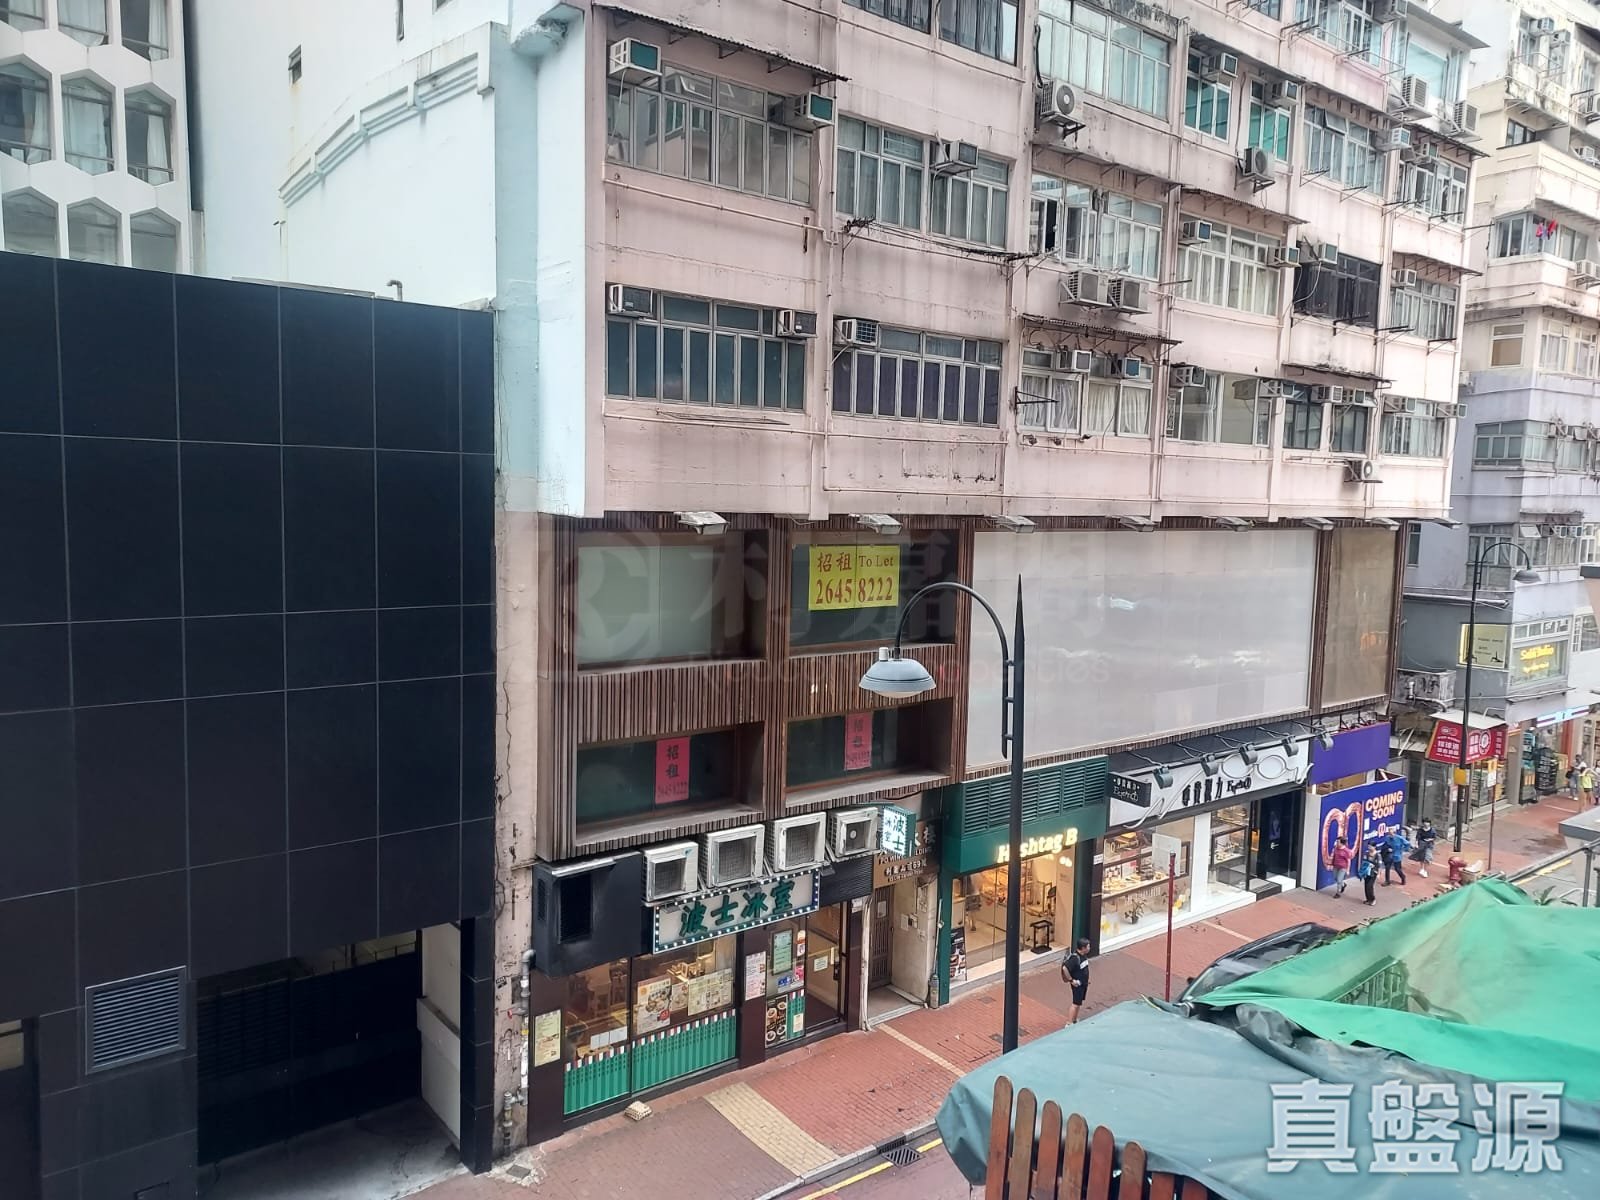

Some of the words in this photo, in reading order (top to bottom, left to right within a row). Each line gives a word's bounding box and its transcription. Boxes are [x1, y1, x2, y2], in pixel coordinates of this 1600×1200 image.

[817, 551, 852, 572] 招租
[858, 555, 873, 567] To
[876, 555, 894, 567] Let
[1366, 791, 1403, 811] COMING
[1372, 804, 1395, 820] SOON
[892, 815, 905, 852] 波士
[996, 832, 1064, 864] Hshtag
[1065, 827, 1079, 846] B
[679, 880, 796, 937] 波士冰室
